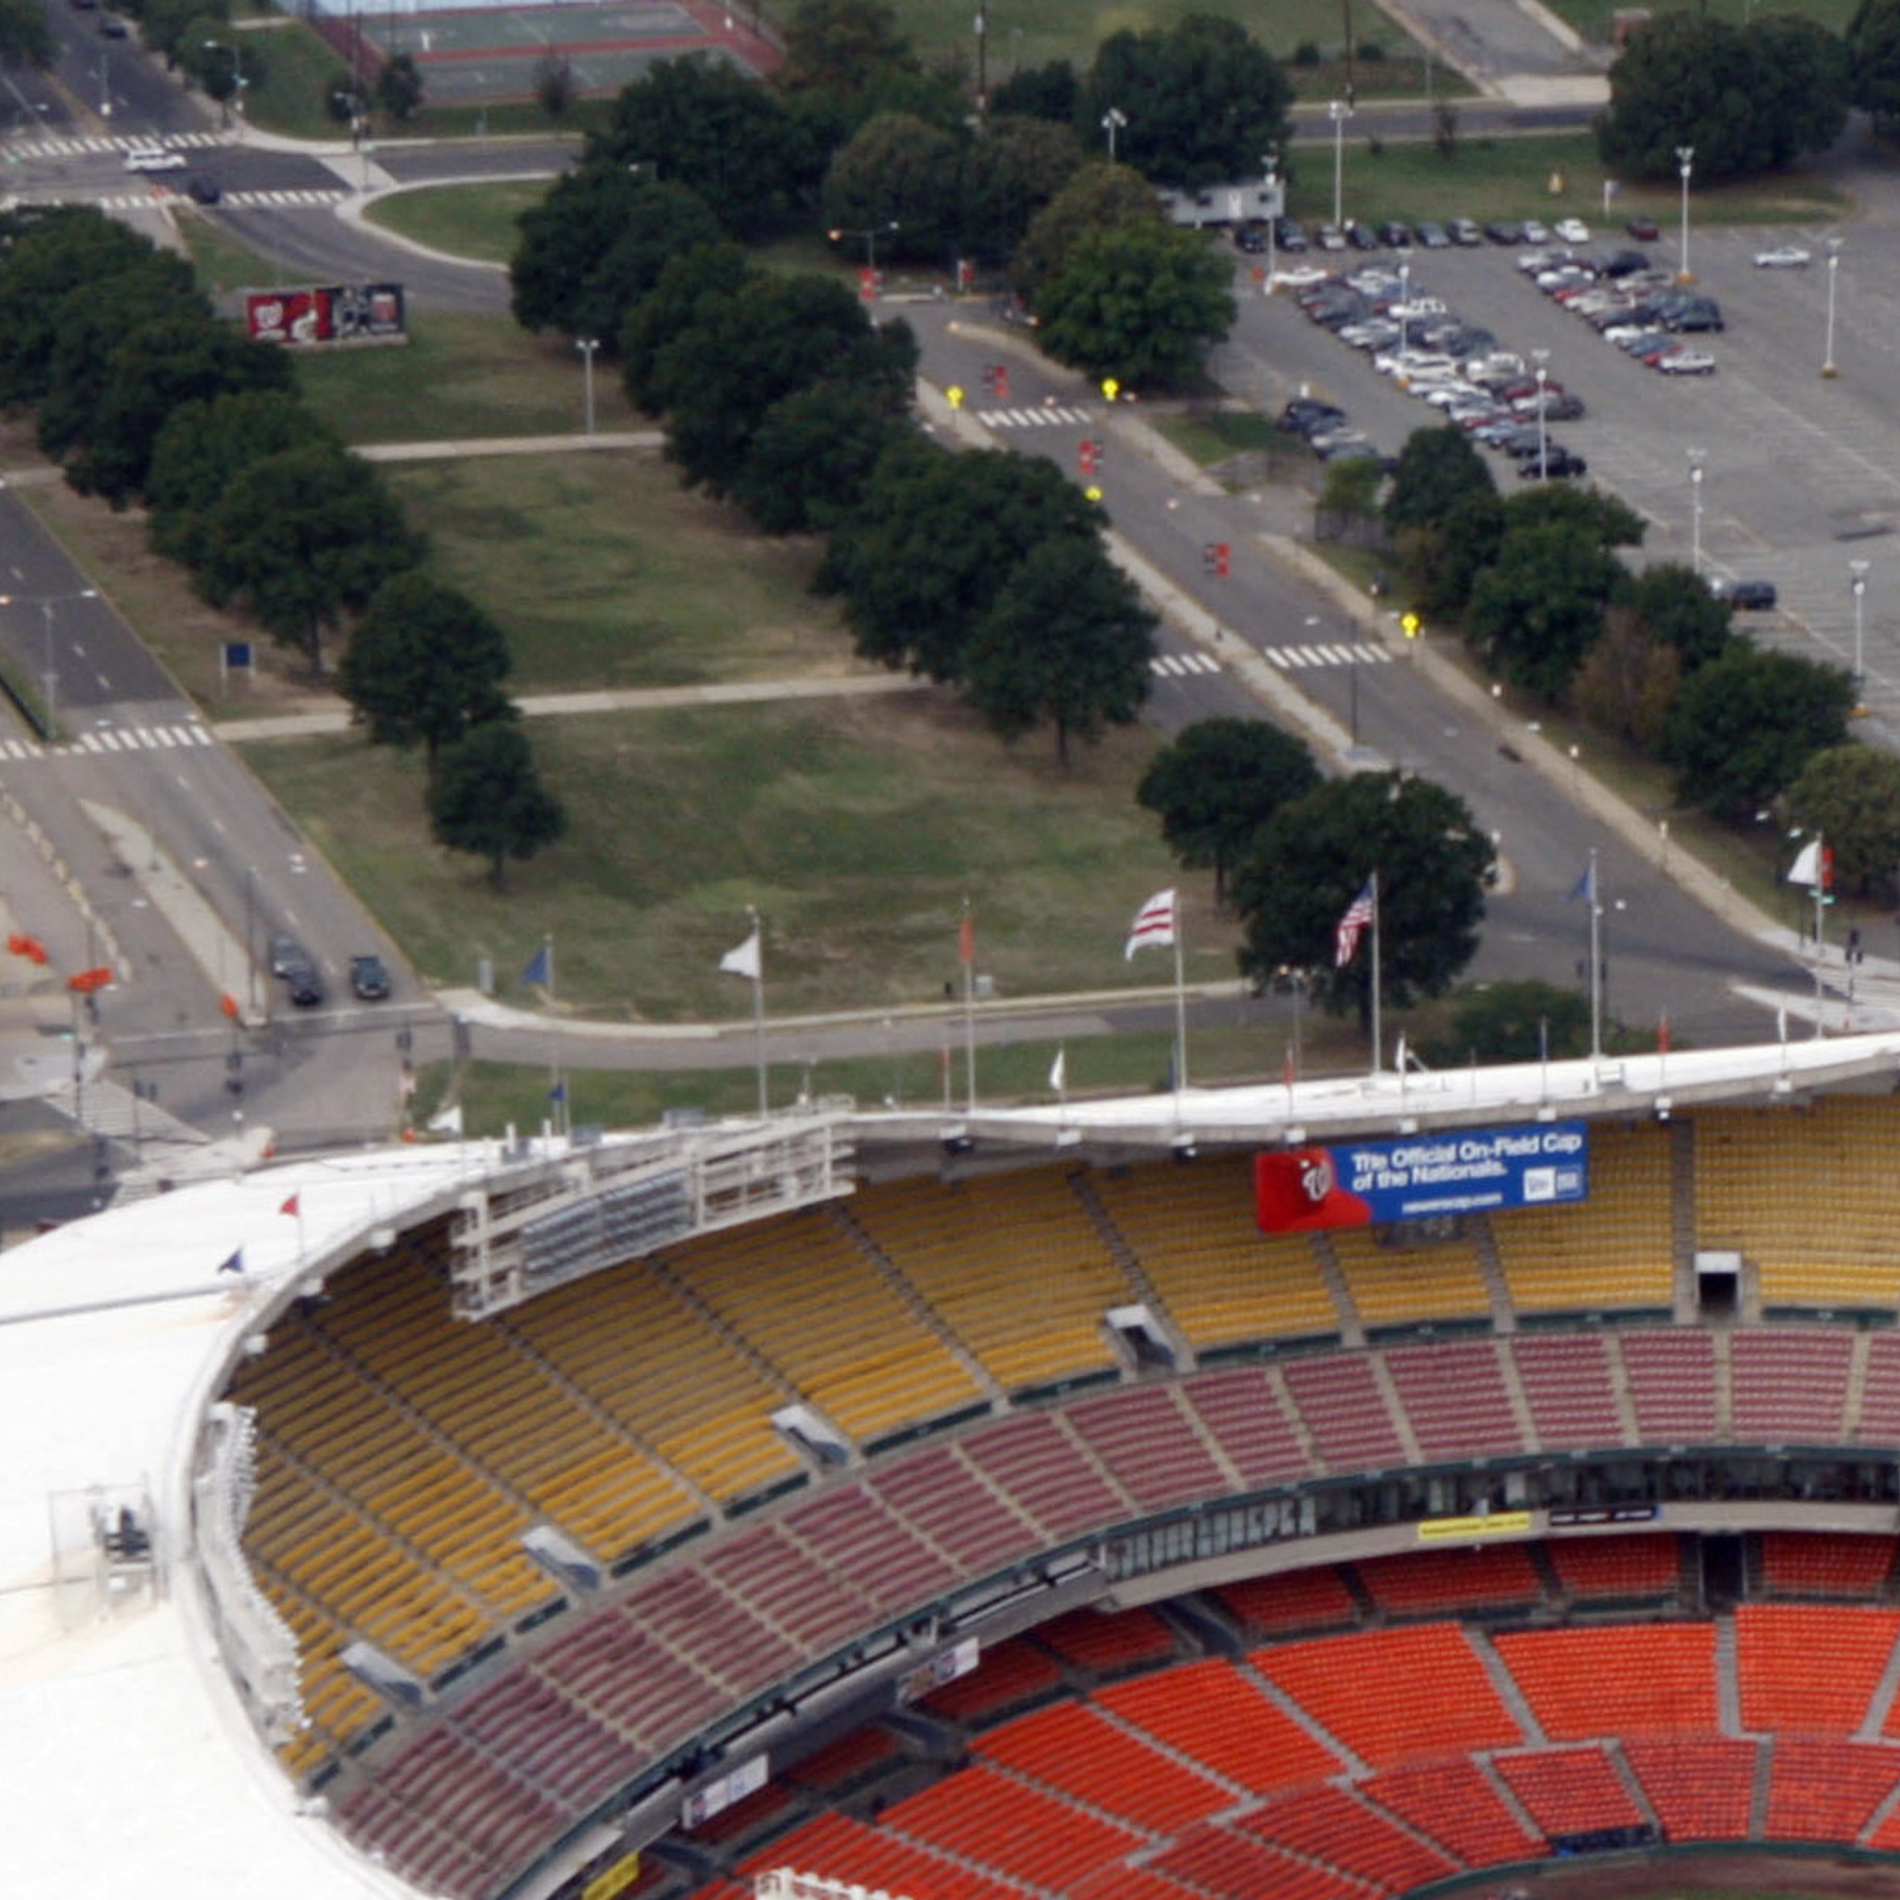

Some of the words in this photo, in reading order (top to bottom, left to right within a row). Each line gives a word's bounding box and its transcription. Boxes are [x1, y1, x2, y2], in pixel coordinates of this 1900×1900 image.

[1352, 1151, 1388, 1173] The
[1391, 1143, 1457, 1169] Official
[1460, 1135, 1540, 1161] On-Field
[1543, 1132, 1583, 1155] Cap
[1352, 1172, 1373, 1192] of
[1377, 1168, 1409, 1189] the
